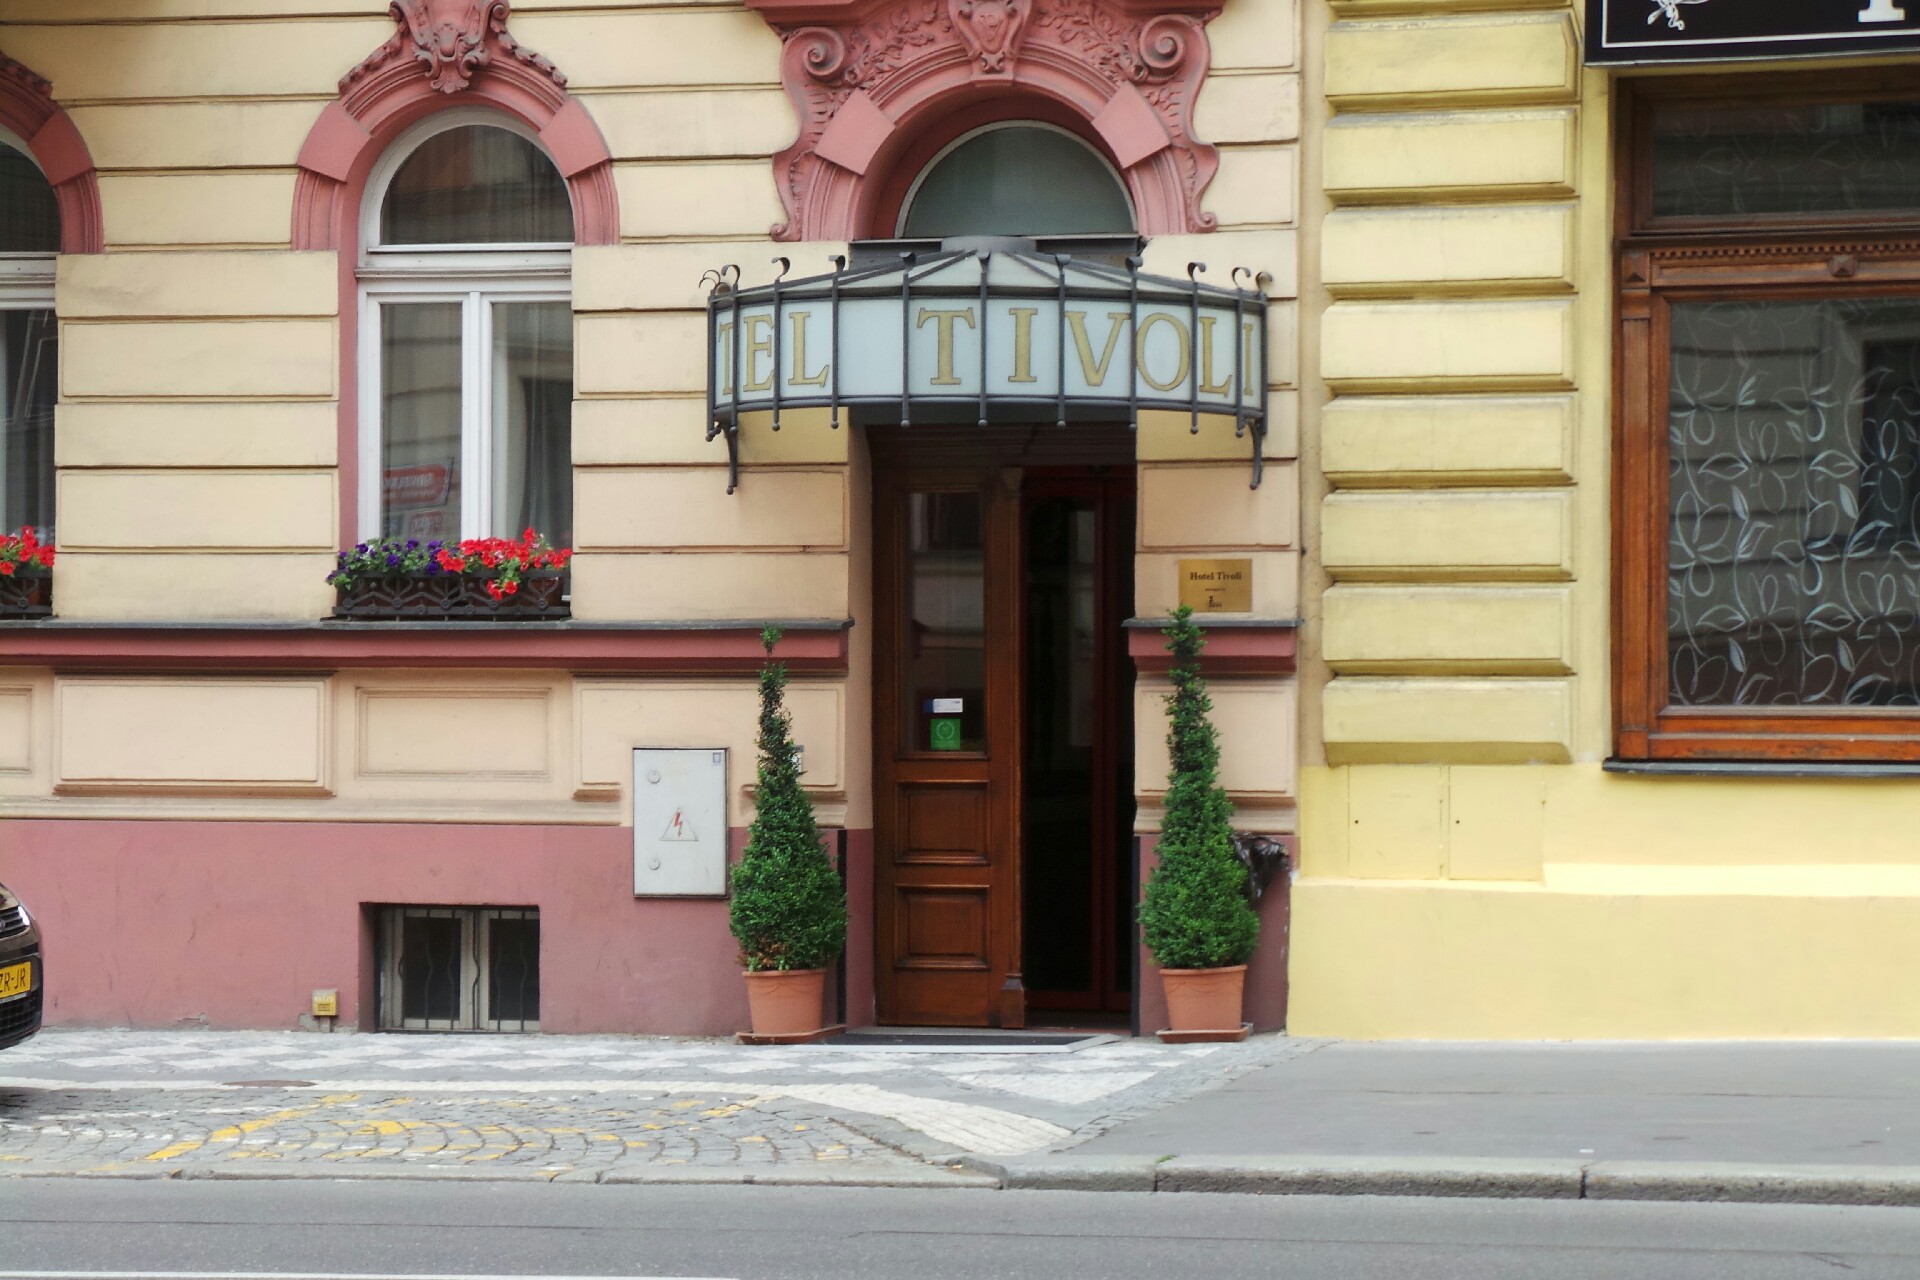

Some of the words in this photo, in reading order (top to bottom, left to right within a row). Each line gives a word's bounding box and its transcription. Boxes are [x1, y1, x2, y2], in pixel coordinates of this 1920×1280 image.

[917, 306, 1254, 398] TIVOLI
[1190, 571, 1214, 581] Hotel
[1216, 571, 1242, 581] Tivoli
